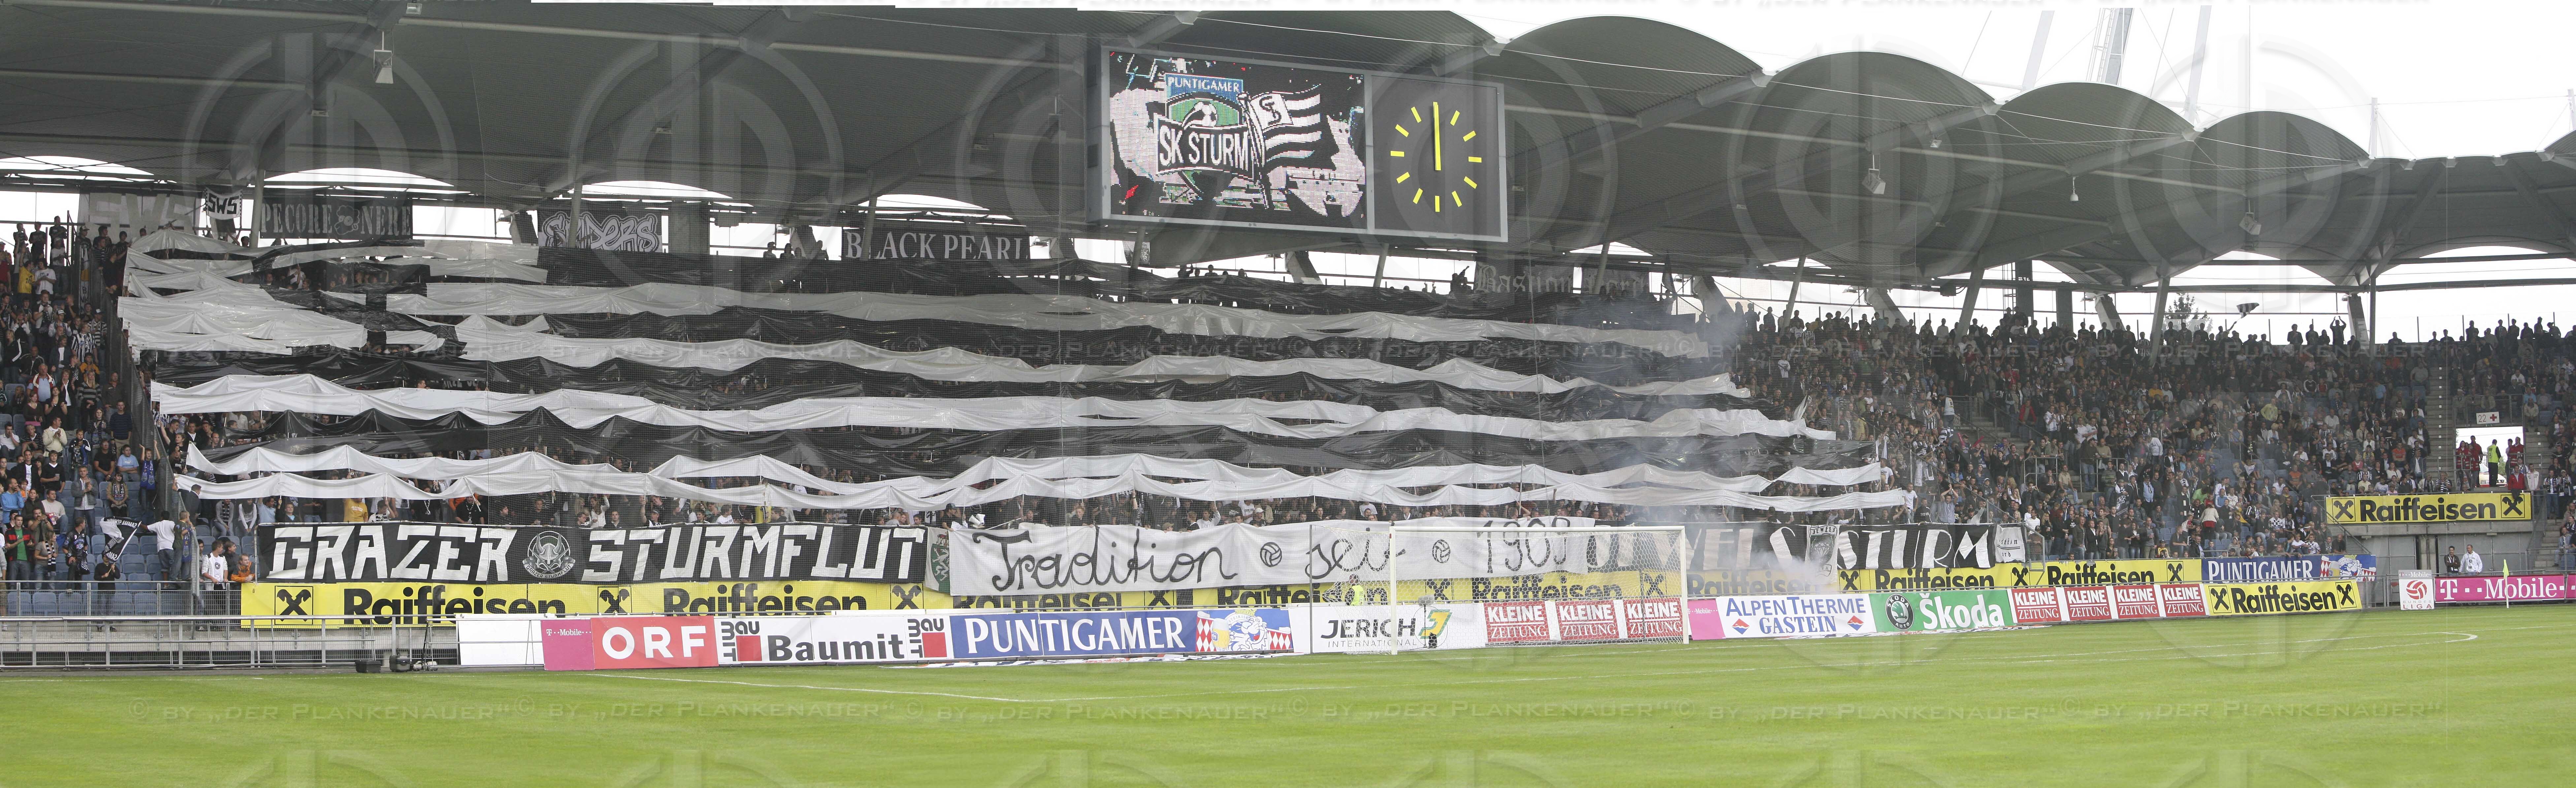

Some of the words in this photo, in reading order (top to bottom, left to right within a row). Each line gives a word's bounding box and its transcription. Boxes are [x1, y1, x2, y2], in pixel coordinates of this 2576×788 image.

[1168, 77, 1240, 92] PUNTIGAMER
[1159, 125, 1183, 166] SK
[1189, 131, 1248, 171] STURM
[208, 193, 239, 214] SWS
[261, 203, 332, 233] PECORE
[360, 205, 411, 236] NERE
[2478, 414, 2487, 423] 22
[2361, 497, 2496, 522] Raiffeisen
[267, 524, 517, 582] GRAZER
[581, 524, 925, 582] STURMFLUT
[972, 526, 1238, 592] Tradition
[1836, 529, 1991, 570] STURM
[1875, 567, 1995, 592] Raiffeisen
[2047, 563, 2154, 587] Raiffeisen
[2208, 560, 2314, 583] PUNTIGAMER
[1471, 575, 1622, 601] Raiffeisen
[2015, 591, 2056, 606] KLEINE
[2067, 590, 2107, 604] KLEINE
[2116, 588, 2154, 602] KLEINE
[2163, 587, 2201, 600] KLEINE
[343, 585, 566, 626] Raiffeisen
[663, 583, 867, 617] Raiffeisen
[2119, 604, 2157, 616] ZEITUNG
[2166, 603, 2204, 614] ZEITUNG
[2231, 585, 2337, 614] Raiffeisen
[1488, 605, 1544, 623] KLEINE
[1559, 603, 1614, 621] KLEINE
[1627, 601, 1680, 620] KLEINE
[1919, 592, 2005, 630] Škoda
[2018, 608, 2059, 620] ZEITUNG
[2070, 606, 2110, 617] ZEITUNG
[965, 616, 1186, 654] PUNTIGAMER
[1321, 618, 1416, 639] JERICH
[1491, 624, 1547, 639] ZEITUNG
[1562, 622, 1617, 637] ZEITUNG
[1630, 620, 1683, 636] ZEITUNG
[1759, 616, 1837, 634] GASTEIN
[602, 625, 707, 659] ORF
[769, 633, 905, 662] Baumit
